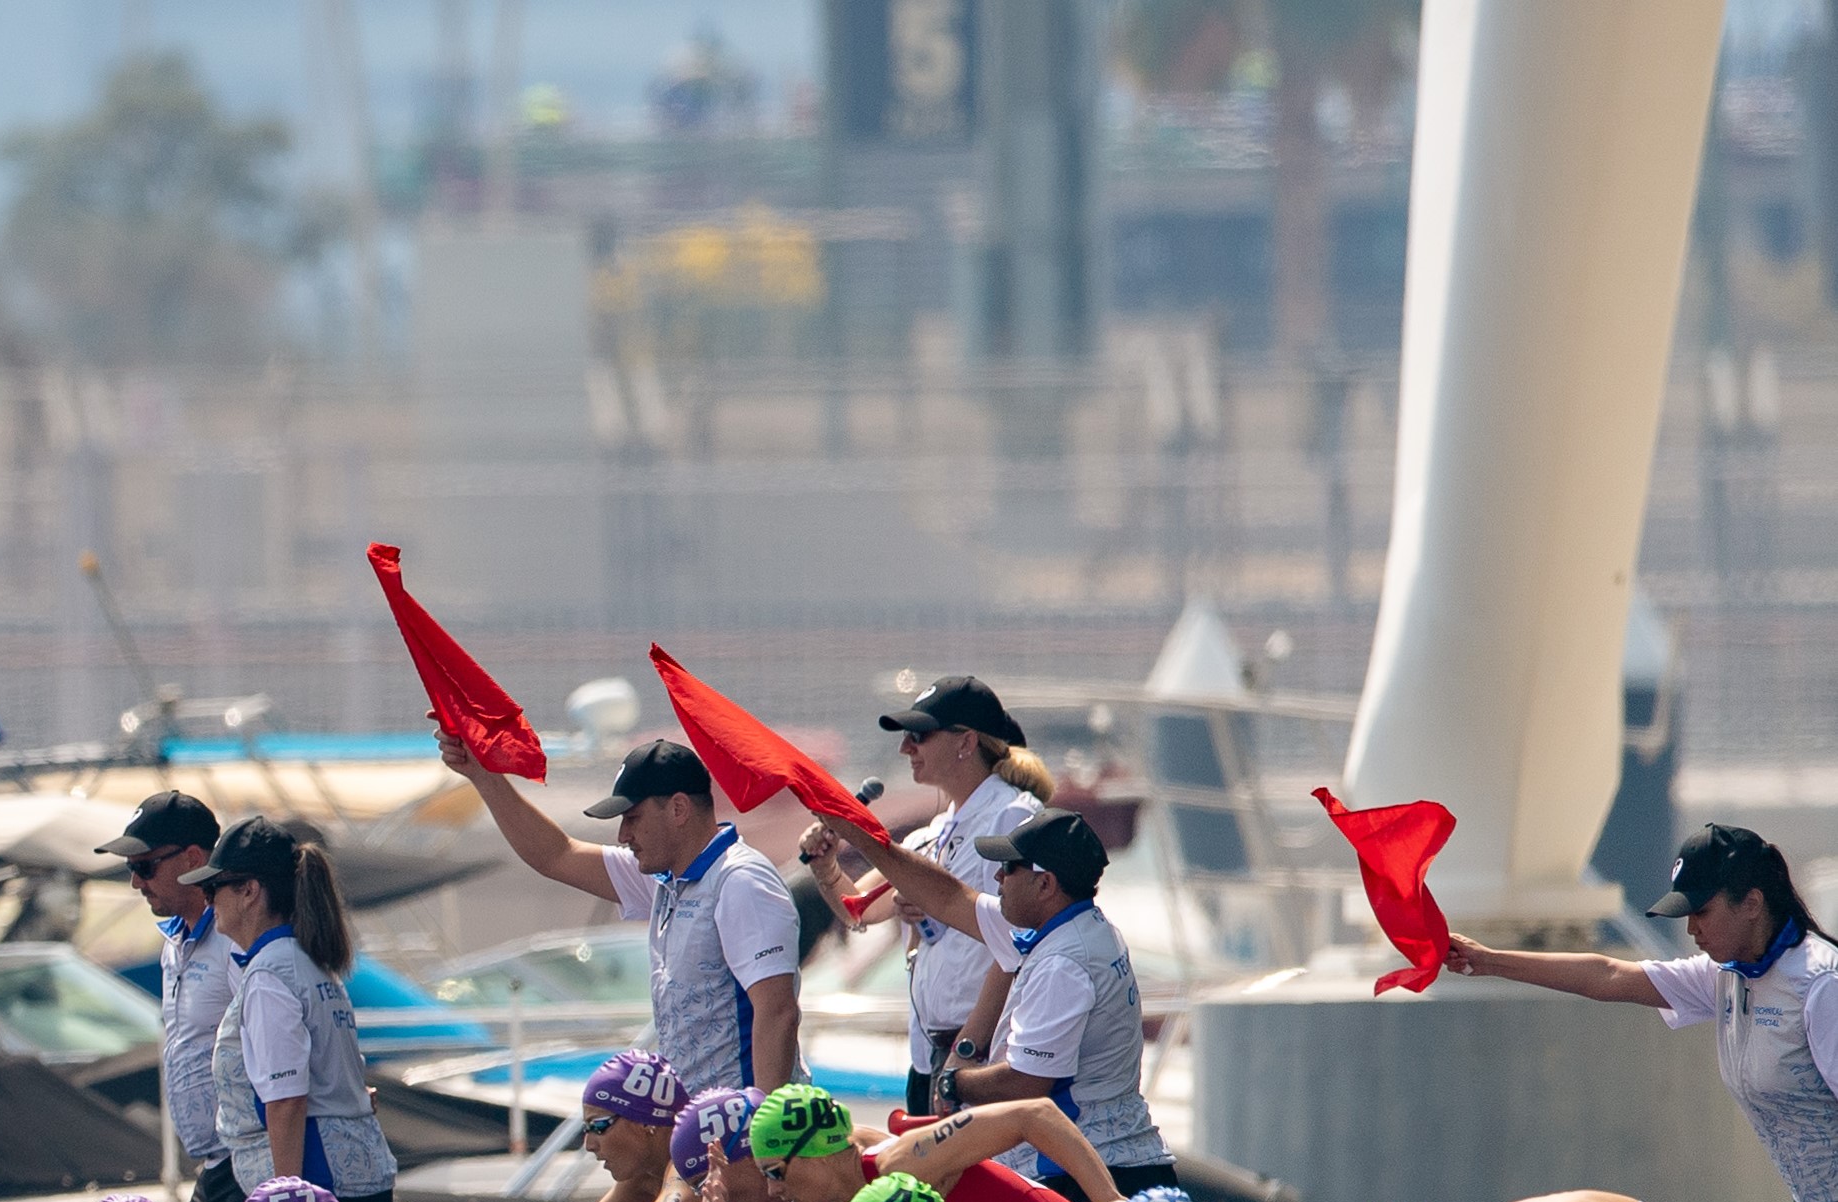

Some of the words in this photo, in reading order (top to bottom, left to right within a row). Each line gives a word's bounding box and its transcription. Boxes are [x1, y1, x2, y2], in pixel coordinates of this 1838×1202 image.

[610, 1095, 631, 1107] NTT
[623, 1062, 675, 1107] 60
[698, 1097, 752, 1145] 58
[781, 1097, 838, 1131] 50
[933, 1111, 974, 1145] 50
